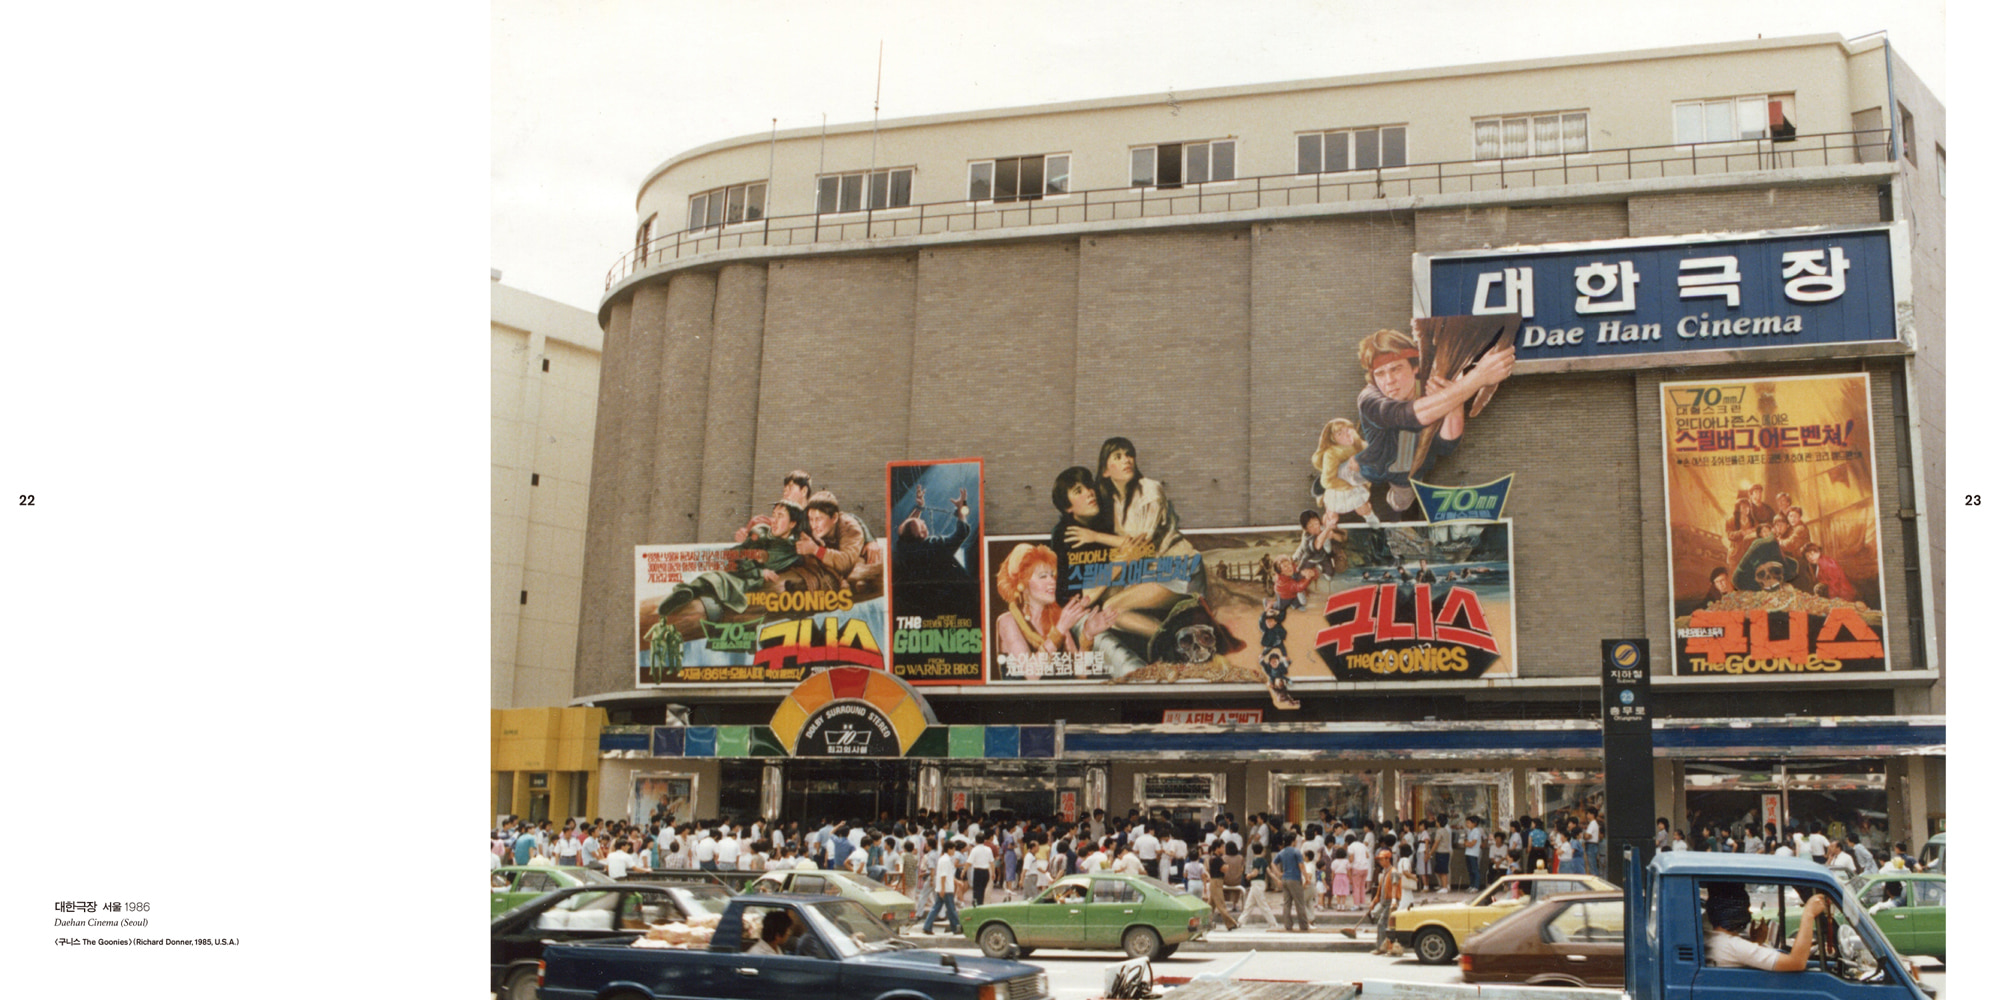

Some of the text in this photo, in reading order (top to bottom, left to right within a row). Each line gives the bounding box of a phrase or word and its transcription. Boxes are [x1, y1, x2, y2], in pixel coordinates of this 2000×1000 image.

[1522, 313, 1803, 349] Dae Han Cinema
[1686, 388, 1738, 407] 70mm
[1432, 488, 1498, 512] 70mm
[1315, 583, 1500, 656] 구니스
[754, 617, 885, 671] 구니스
[1685, 608, 1885, 666] 구니스
[906, 664, 952, 676] WARNER
[953, 663, 979, 676] BROS
[1610, 670, 1643, 679] 지하철
[806, 705, 891, 739] DOLBY SURROUND STEREO
